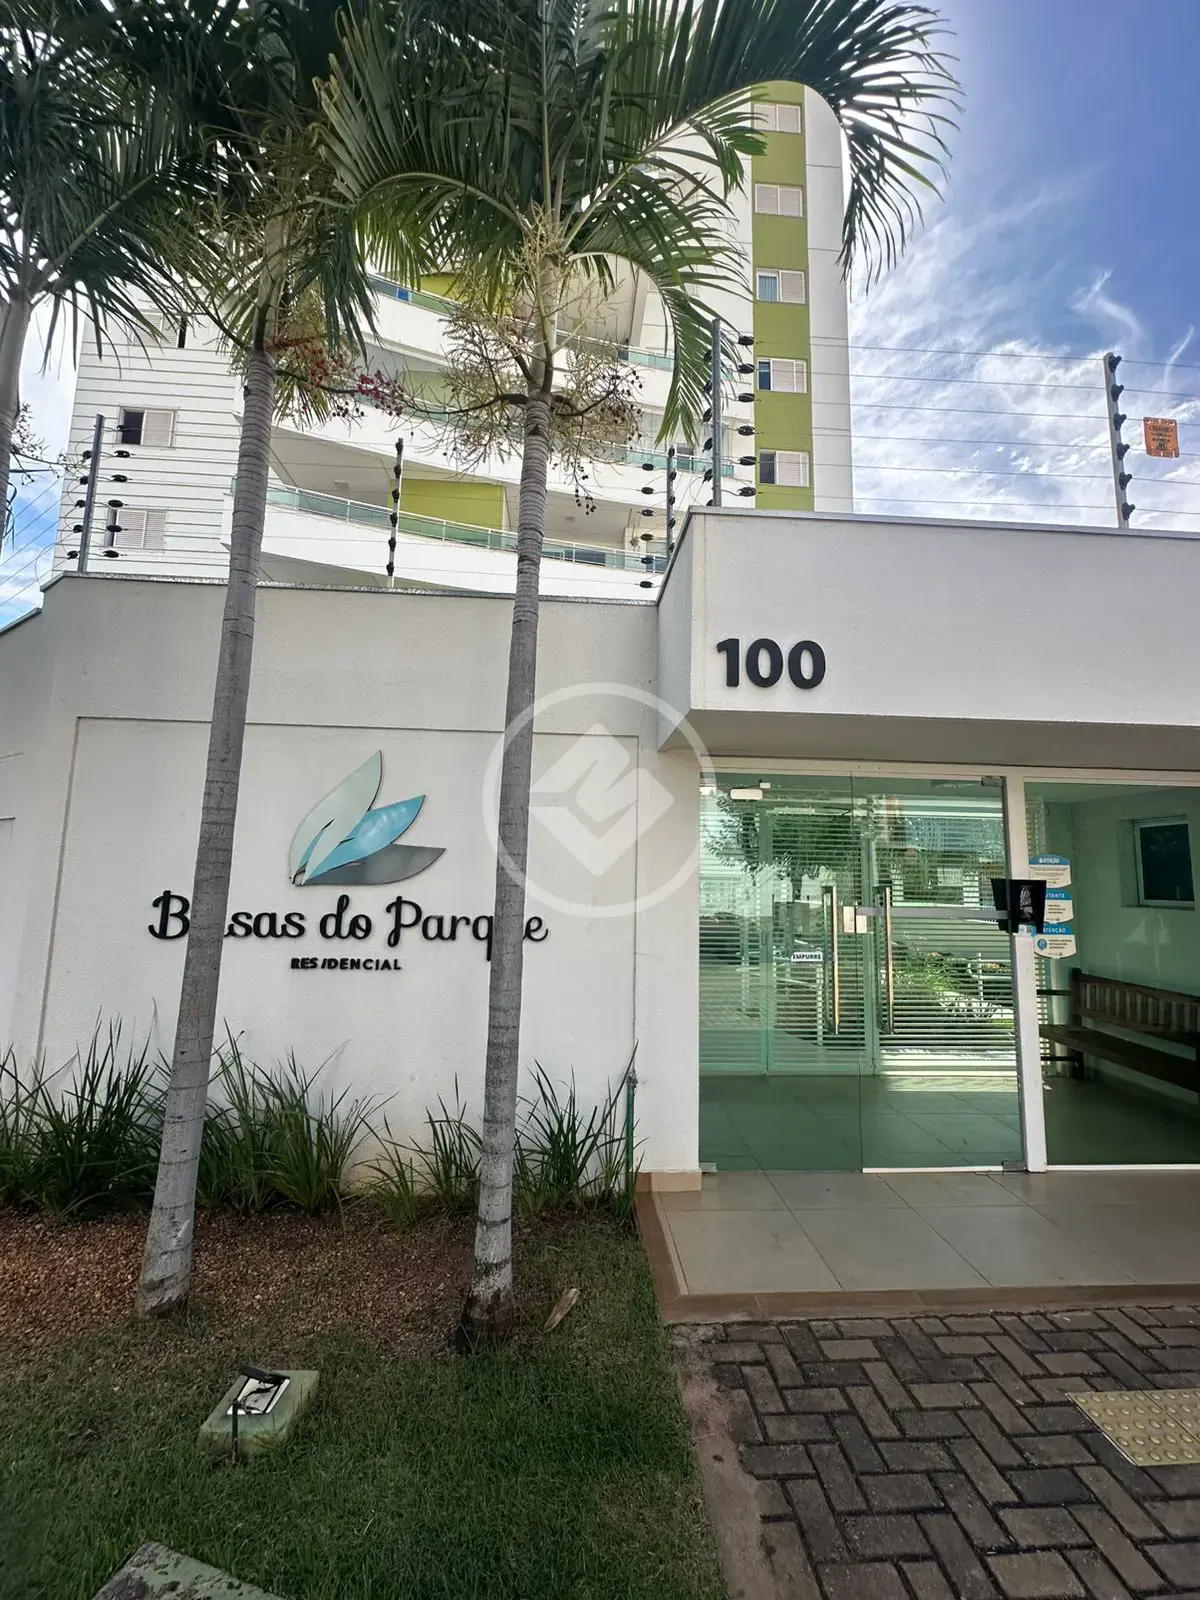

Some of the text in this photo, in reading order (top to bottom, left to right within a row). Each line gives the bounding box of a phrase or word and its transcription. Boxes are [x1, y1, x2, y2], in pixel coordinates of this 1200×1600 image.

[716, 637, 827, 690] 100
[147, 889, 549, 962] Bsas do Parqe
[290, 957, 402, 971] RESIDENCIAL
